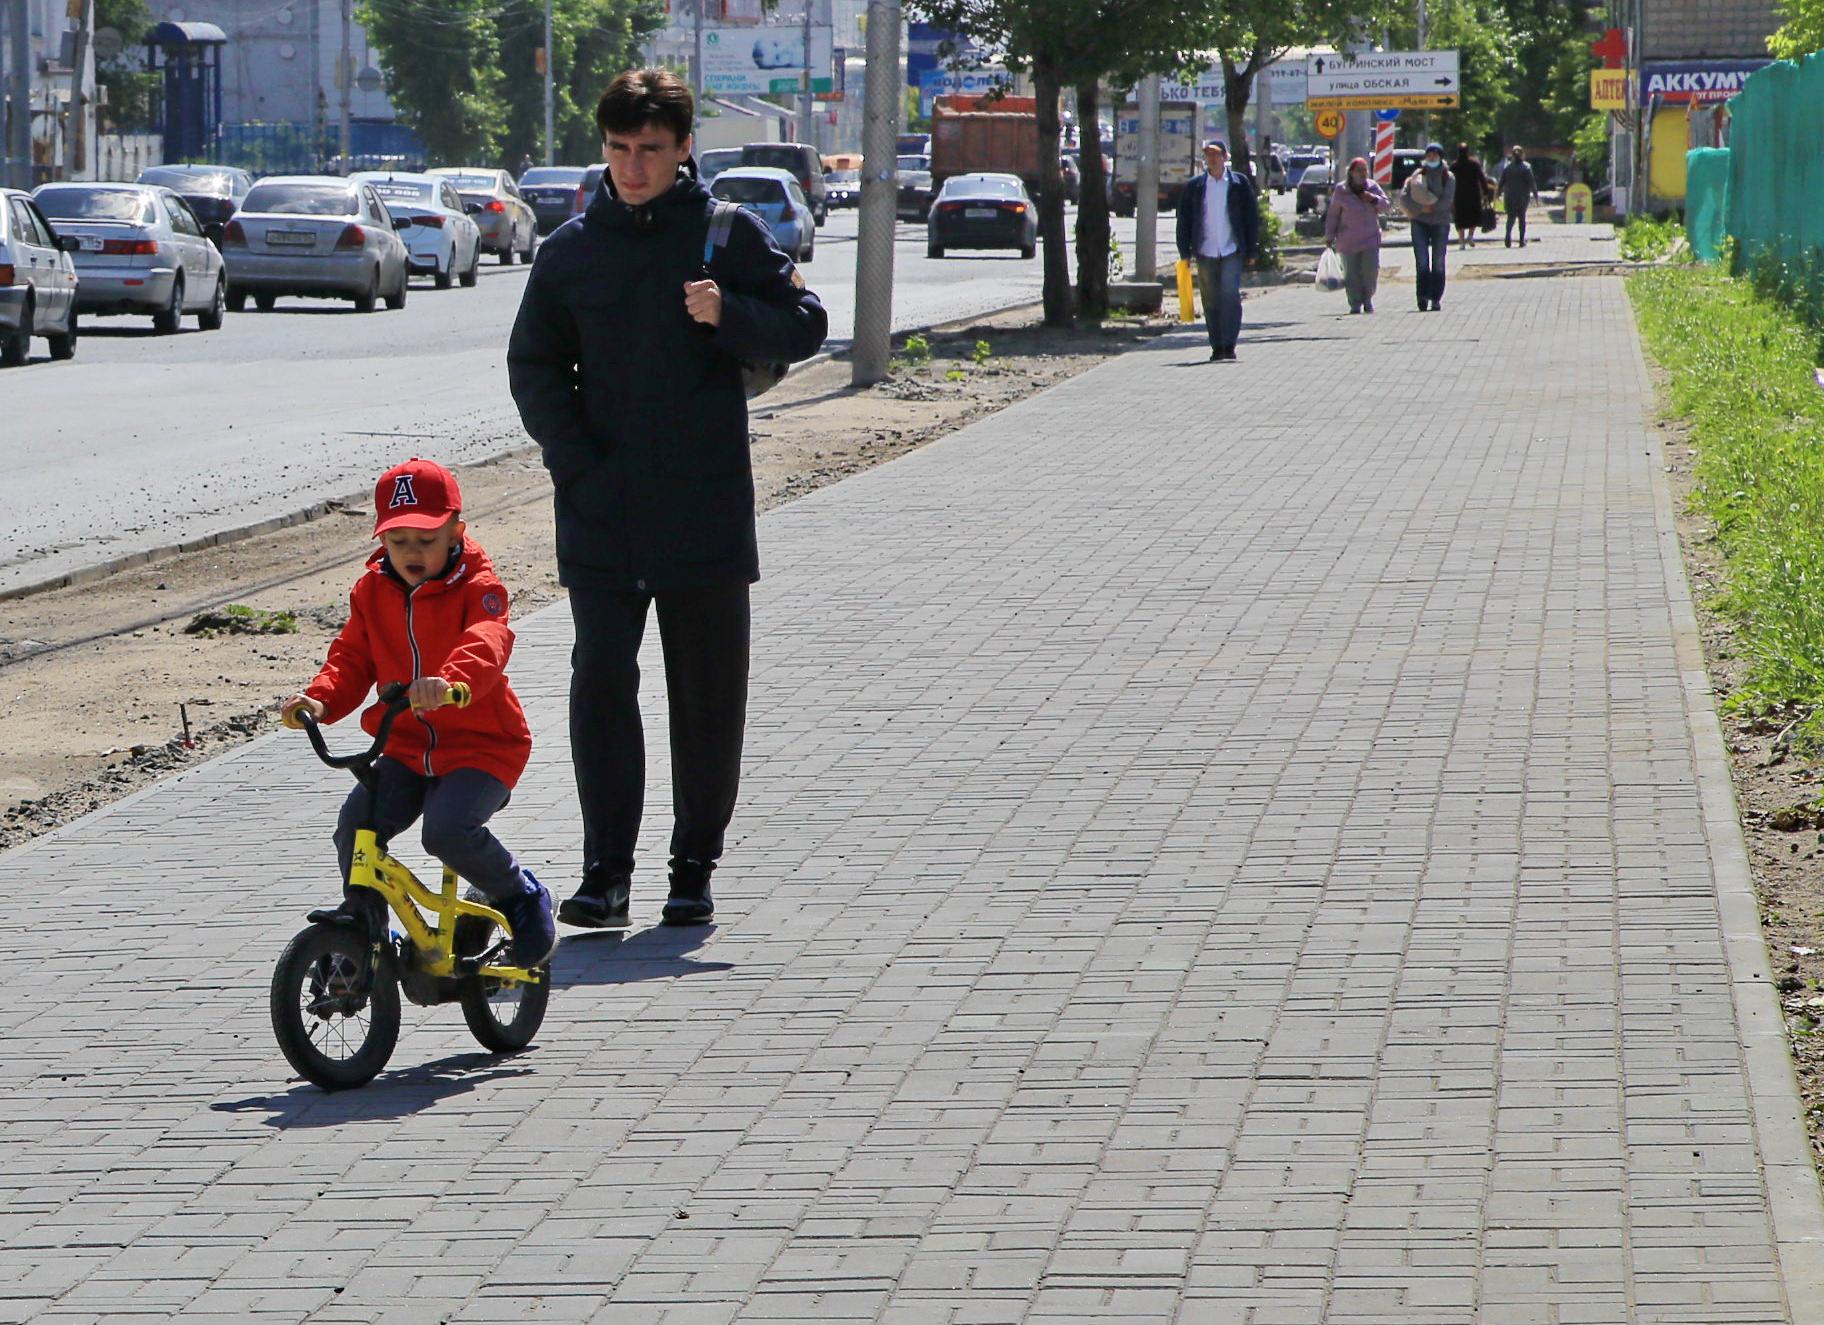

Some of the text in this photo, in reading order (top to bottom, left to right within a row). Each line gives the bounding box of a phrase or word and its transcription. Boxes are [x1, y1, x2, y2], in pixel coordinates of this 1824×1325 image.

[1329, 56, 1436, 70] БУГРИНСКИЙ МОСТ
[1329, 78, 1410, 92] улица ОБСКАЯ
[1322, 117, 1338, 128] 40
[389, 474, 418, 509] A
